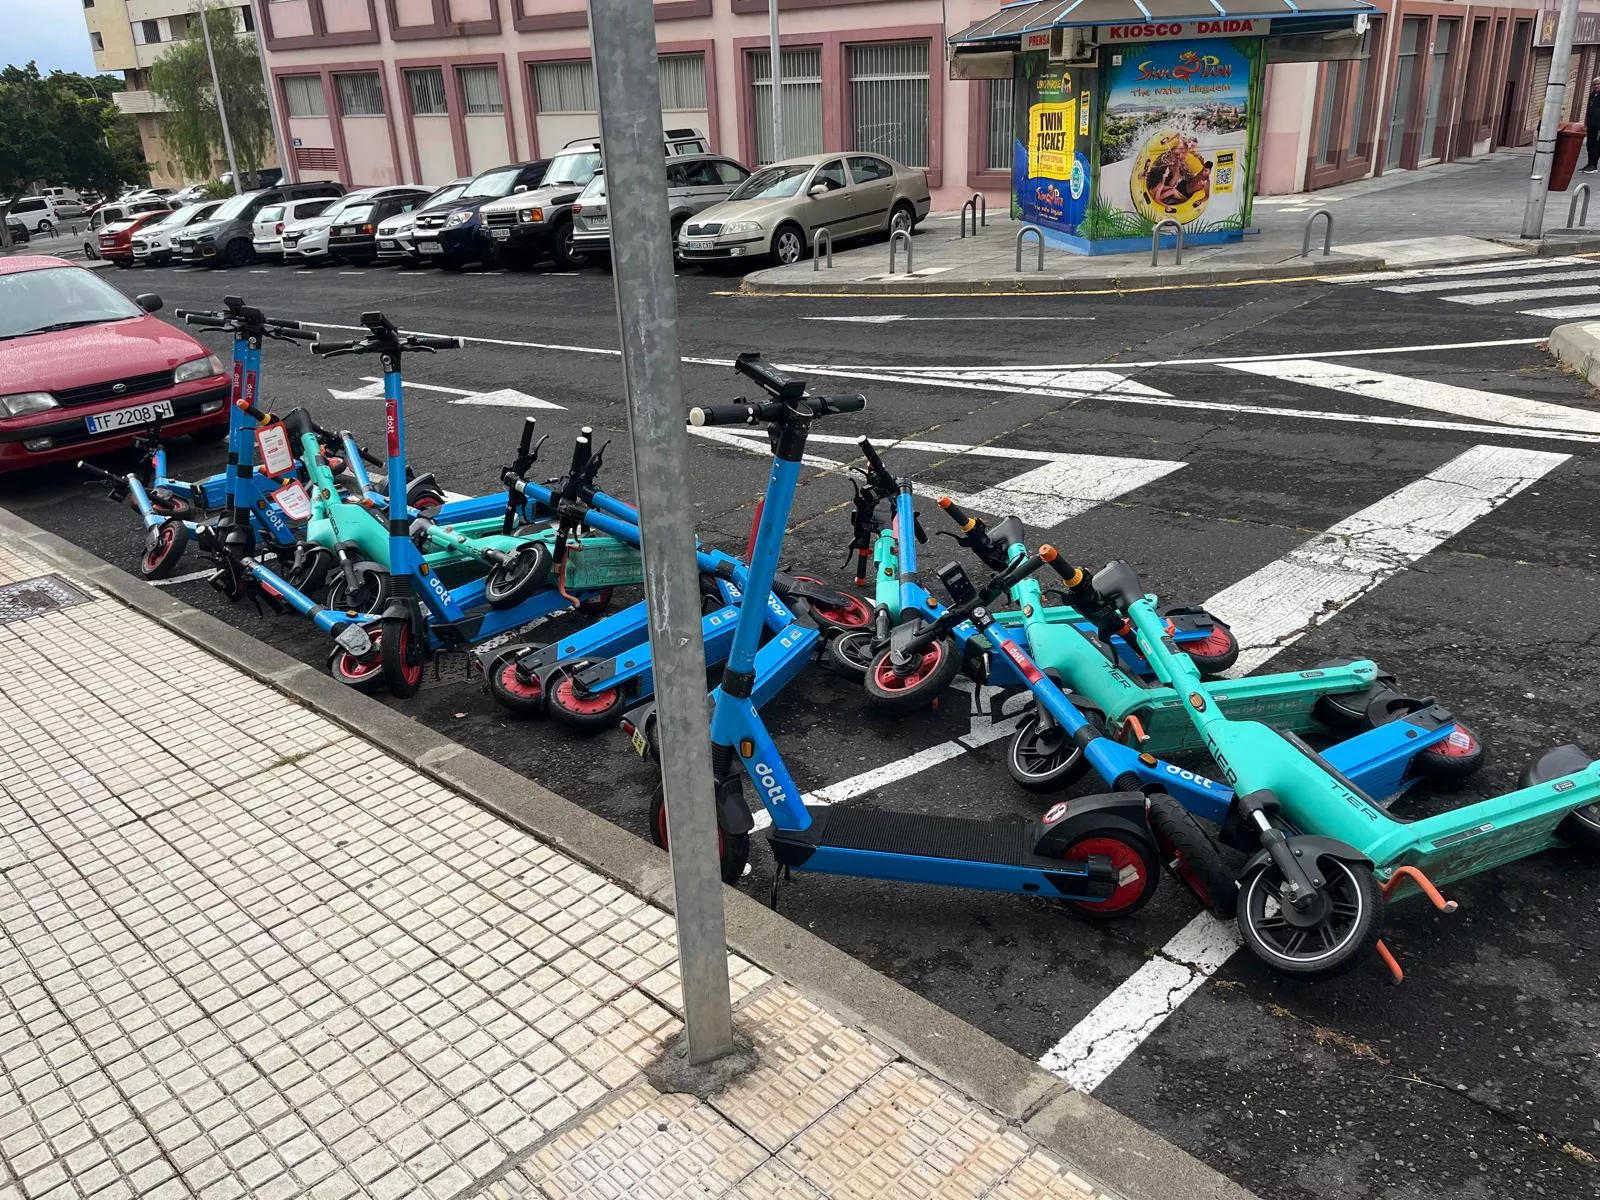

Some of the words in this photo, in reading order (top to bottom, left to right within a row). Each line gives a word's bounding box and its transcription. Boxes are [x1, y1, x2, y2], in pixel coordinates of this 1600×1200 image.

[1110, 23, 1182, 39] KIOSCO
[1040, 112, 1063, 131] TWIN
[1037, 132, 1066, 151] TICKET
[94, 414, 112, 429] TF
[115, 407, 151, 425] 2208
[265, 509, 285, 532] dott
[429, 577, 451, 607] dott
[1010, 647, 1026, 663] dott
[1103, 661, 1132, 689] TIER
[1206, 732, 1238, 787] TIER
[755, 762, 787, 806] dott
[1165, 765, 1214, 789] dott
[1329, 779, 1378, 821] TIER
